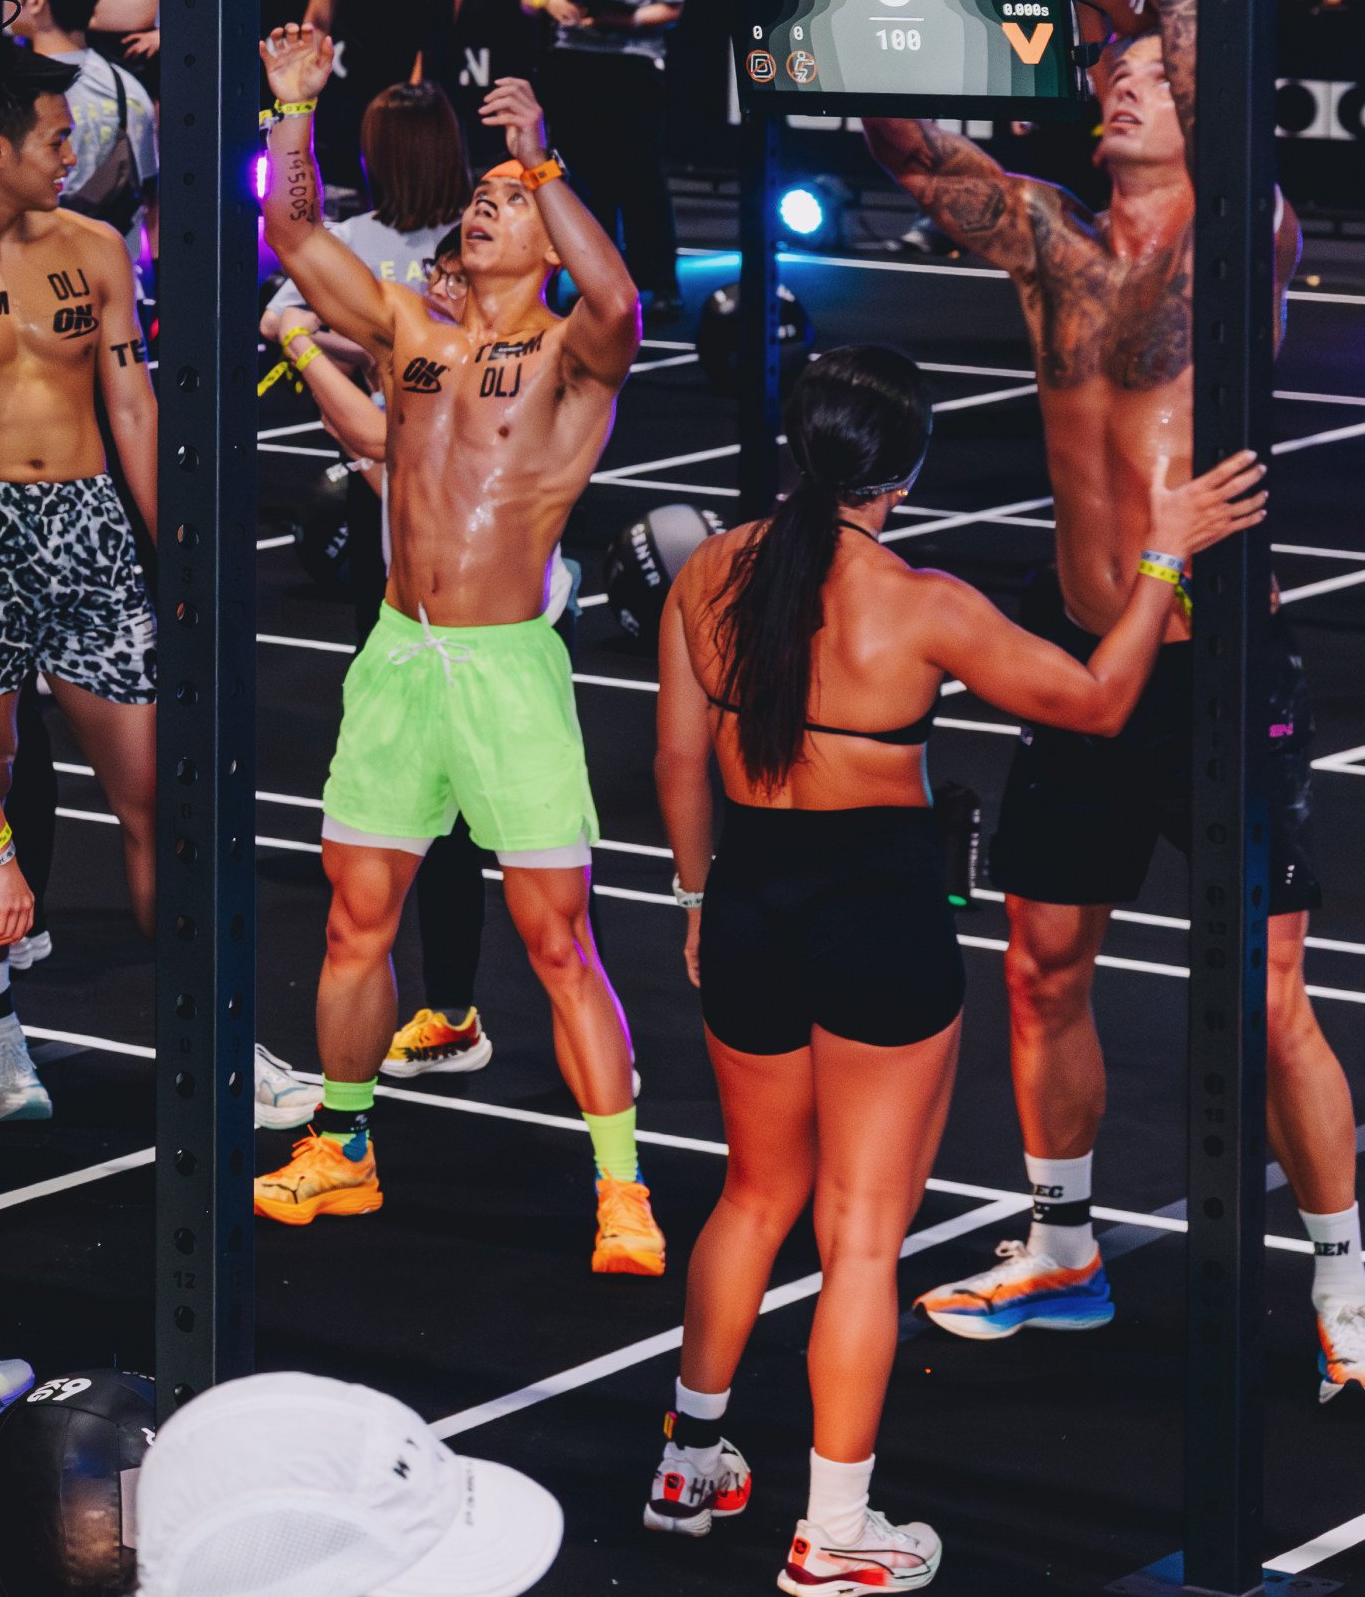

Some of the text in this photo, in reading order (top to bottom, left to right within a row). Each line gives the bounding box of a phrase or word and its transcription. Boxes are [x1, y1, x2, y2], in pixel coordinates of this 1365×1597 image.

[1003, 3, 1050, 17] 0.000s
[753, 25, 804, 41] 0 0
[876, 28, 922, 51] 100
[46, 269, 91, 301] DLJ
[110, 339, 147, 368] TE
[474, 330, 545, 363] TEAM
[479, 364, 520, 398] DLJ
